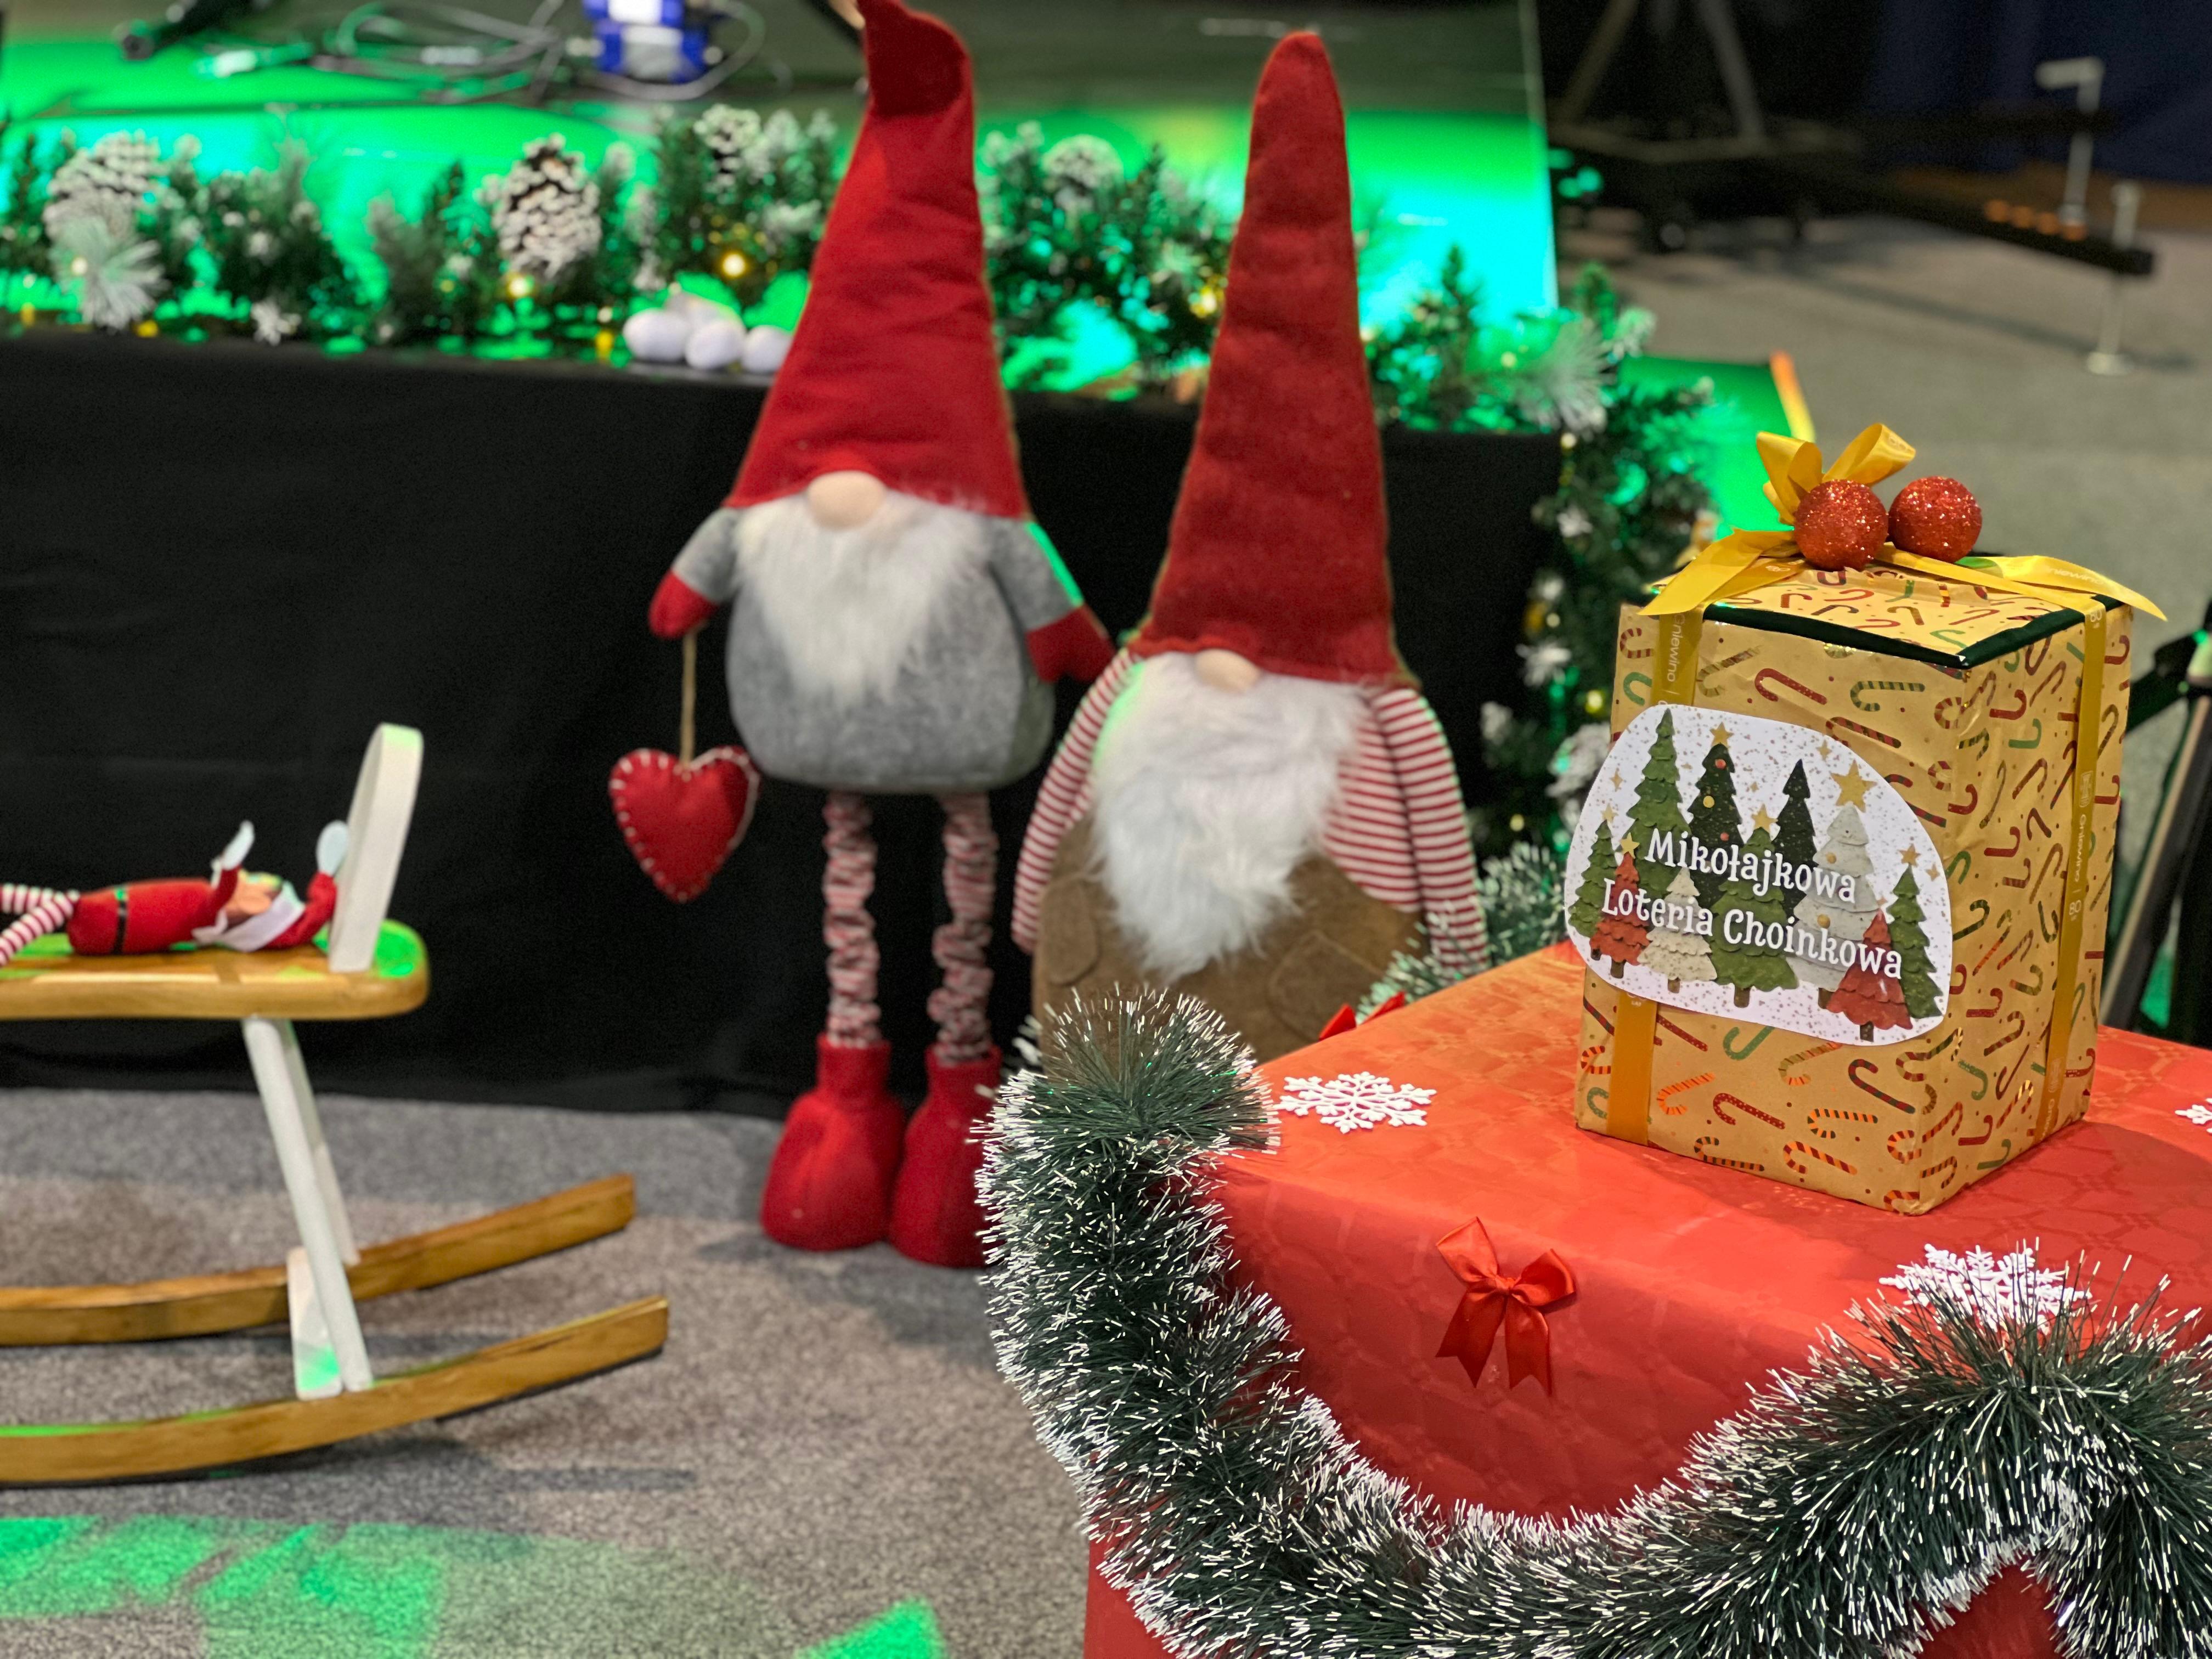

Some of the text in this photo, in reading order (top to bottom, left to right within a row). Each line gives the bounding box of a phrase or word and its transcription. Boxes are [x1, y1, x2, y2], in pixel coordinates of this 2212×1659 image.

[1644, 828, 1856, 904] Mikołajkowa
[1601, 878, 1902, 980] Loteria Choinkowa
